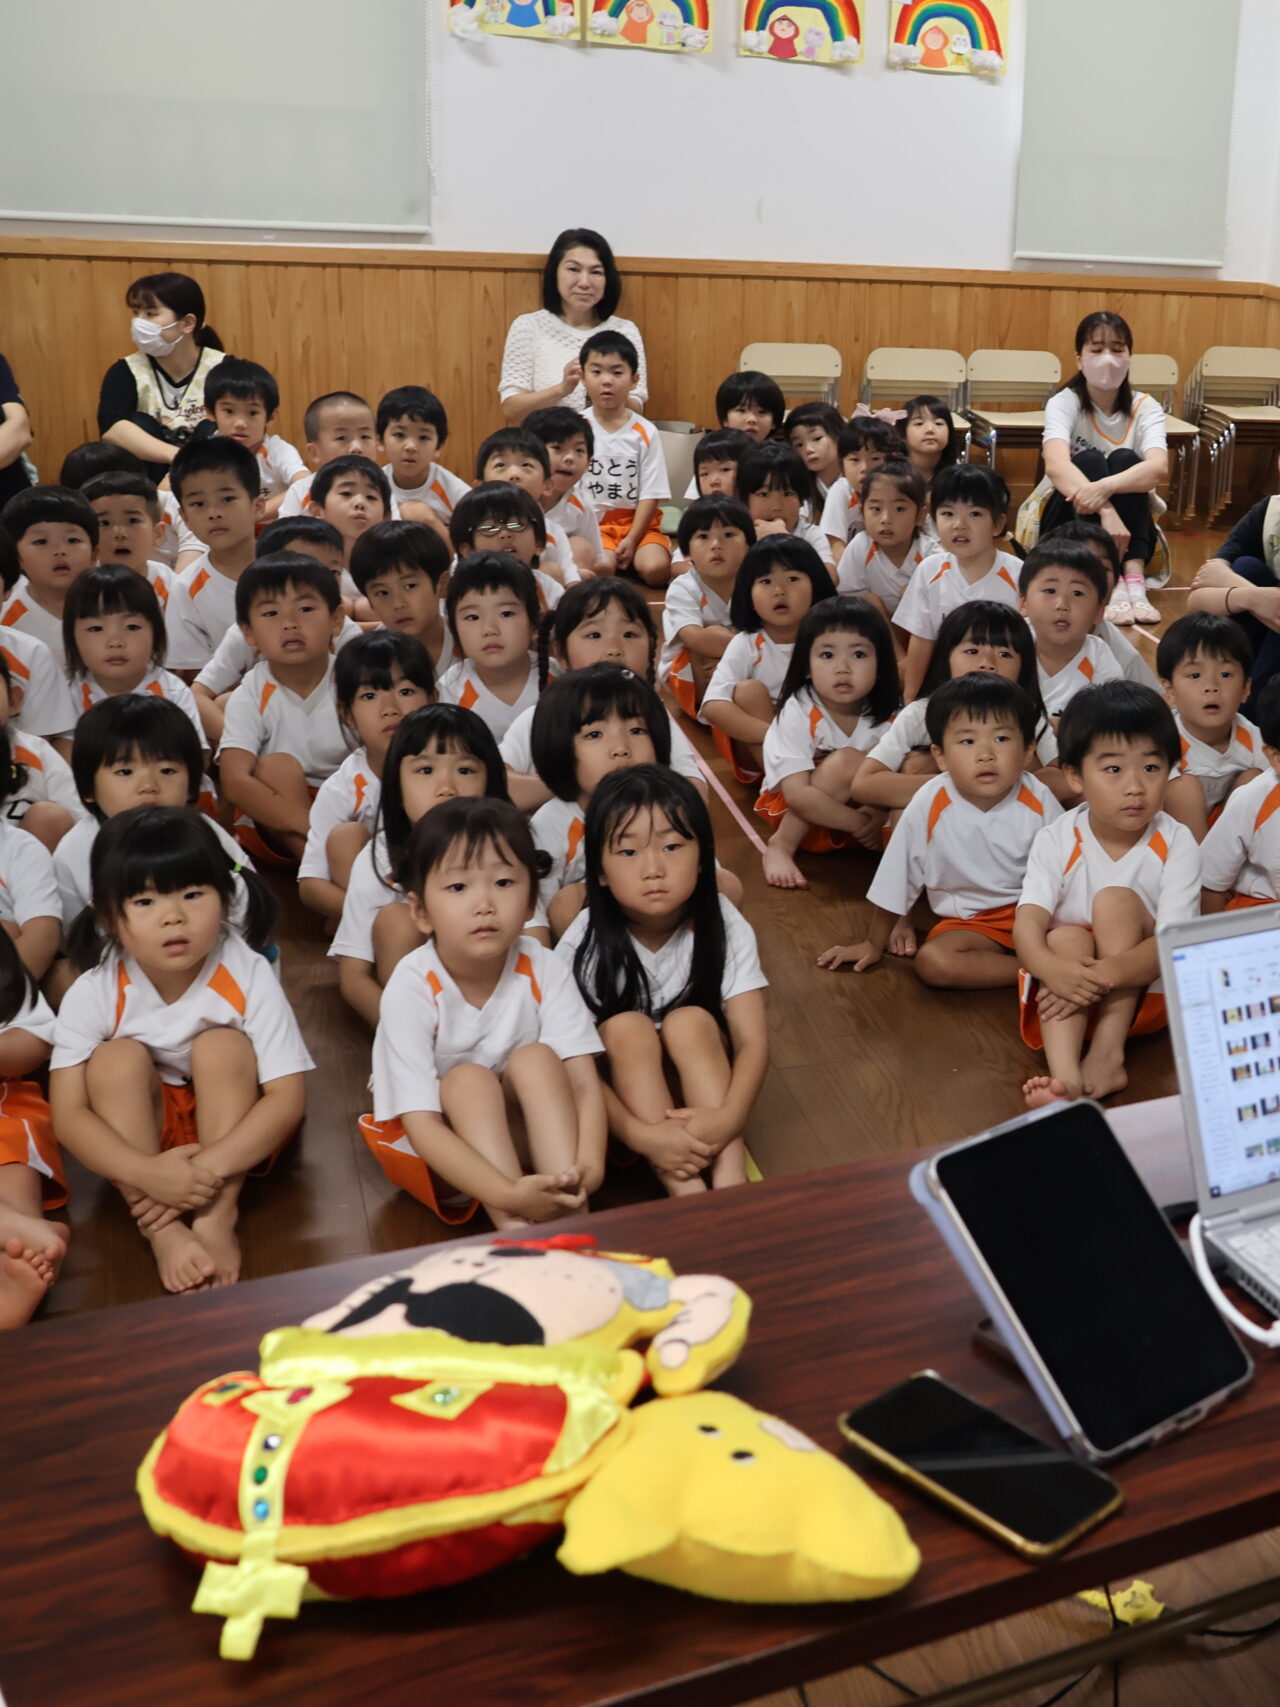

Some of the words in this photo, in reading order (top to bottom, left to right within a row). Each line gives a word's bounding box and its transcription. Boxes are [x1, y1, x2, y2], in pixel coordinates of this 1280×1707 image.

[589, 458, 637, 478] むとう
[588, 481, 637, 501] やまと
